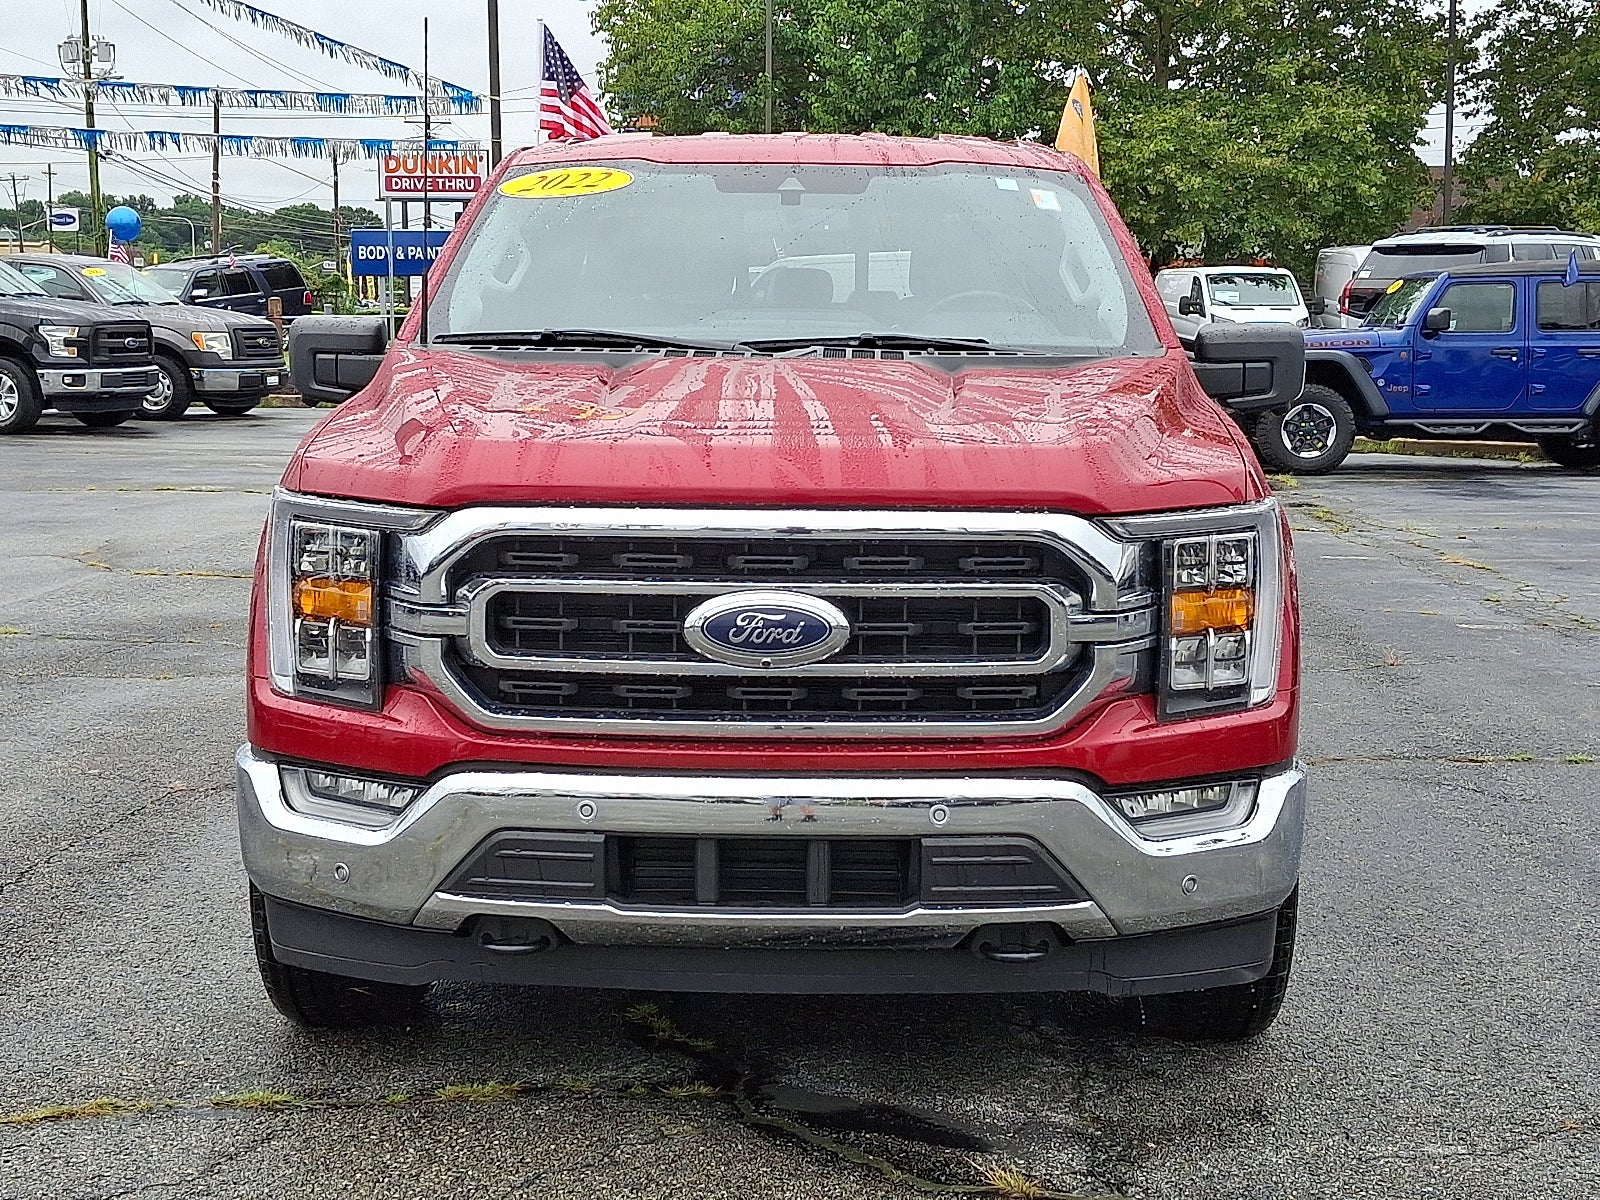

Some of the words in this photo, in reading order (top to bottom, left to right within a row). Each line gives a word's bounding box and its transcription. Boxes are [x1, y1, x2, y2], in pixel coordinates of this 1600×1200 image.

[384, 154, 484, 175] DUNKIN'
[391, 178, 433, 190] DRIVE
[436, 178, 474, 190] THRU
[517, 172, 613, 192] 2022
[396, 246, 405, 260] &
[1386, 384, 1409, 392] Jeep
[728, 612, 804, 644] Ford
